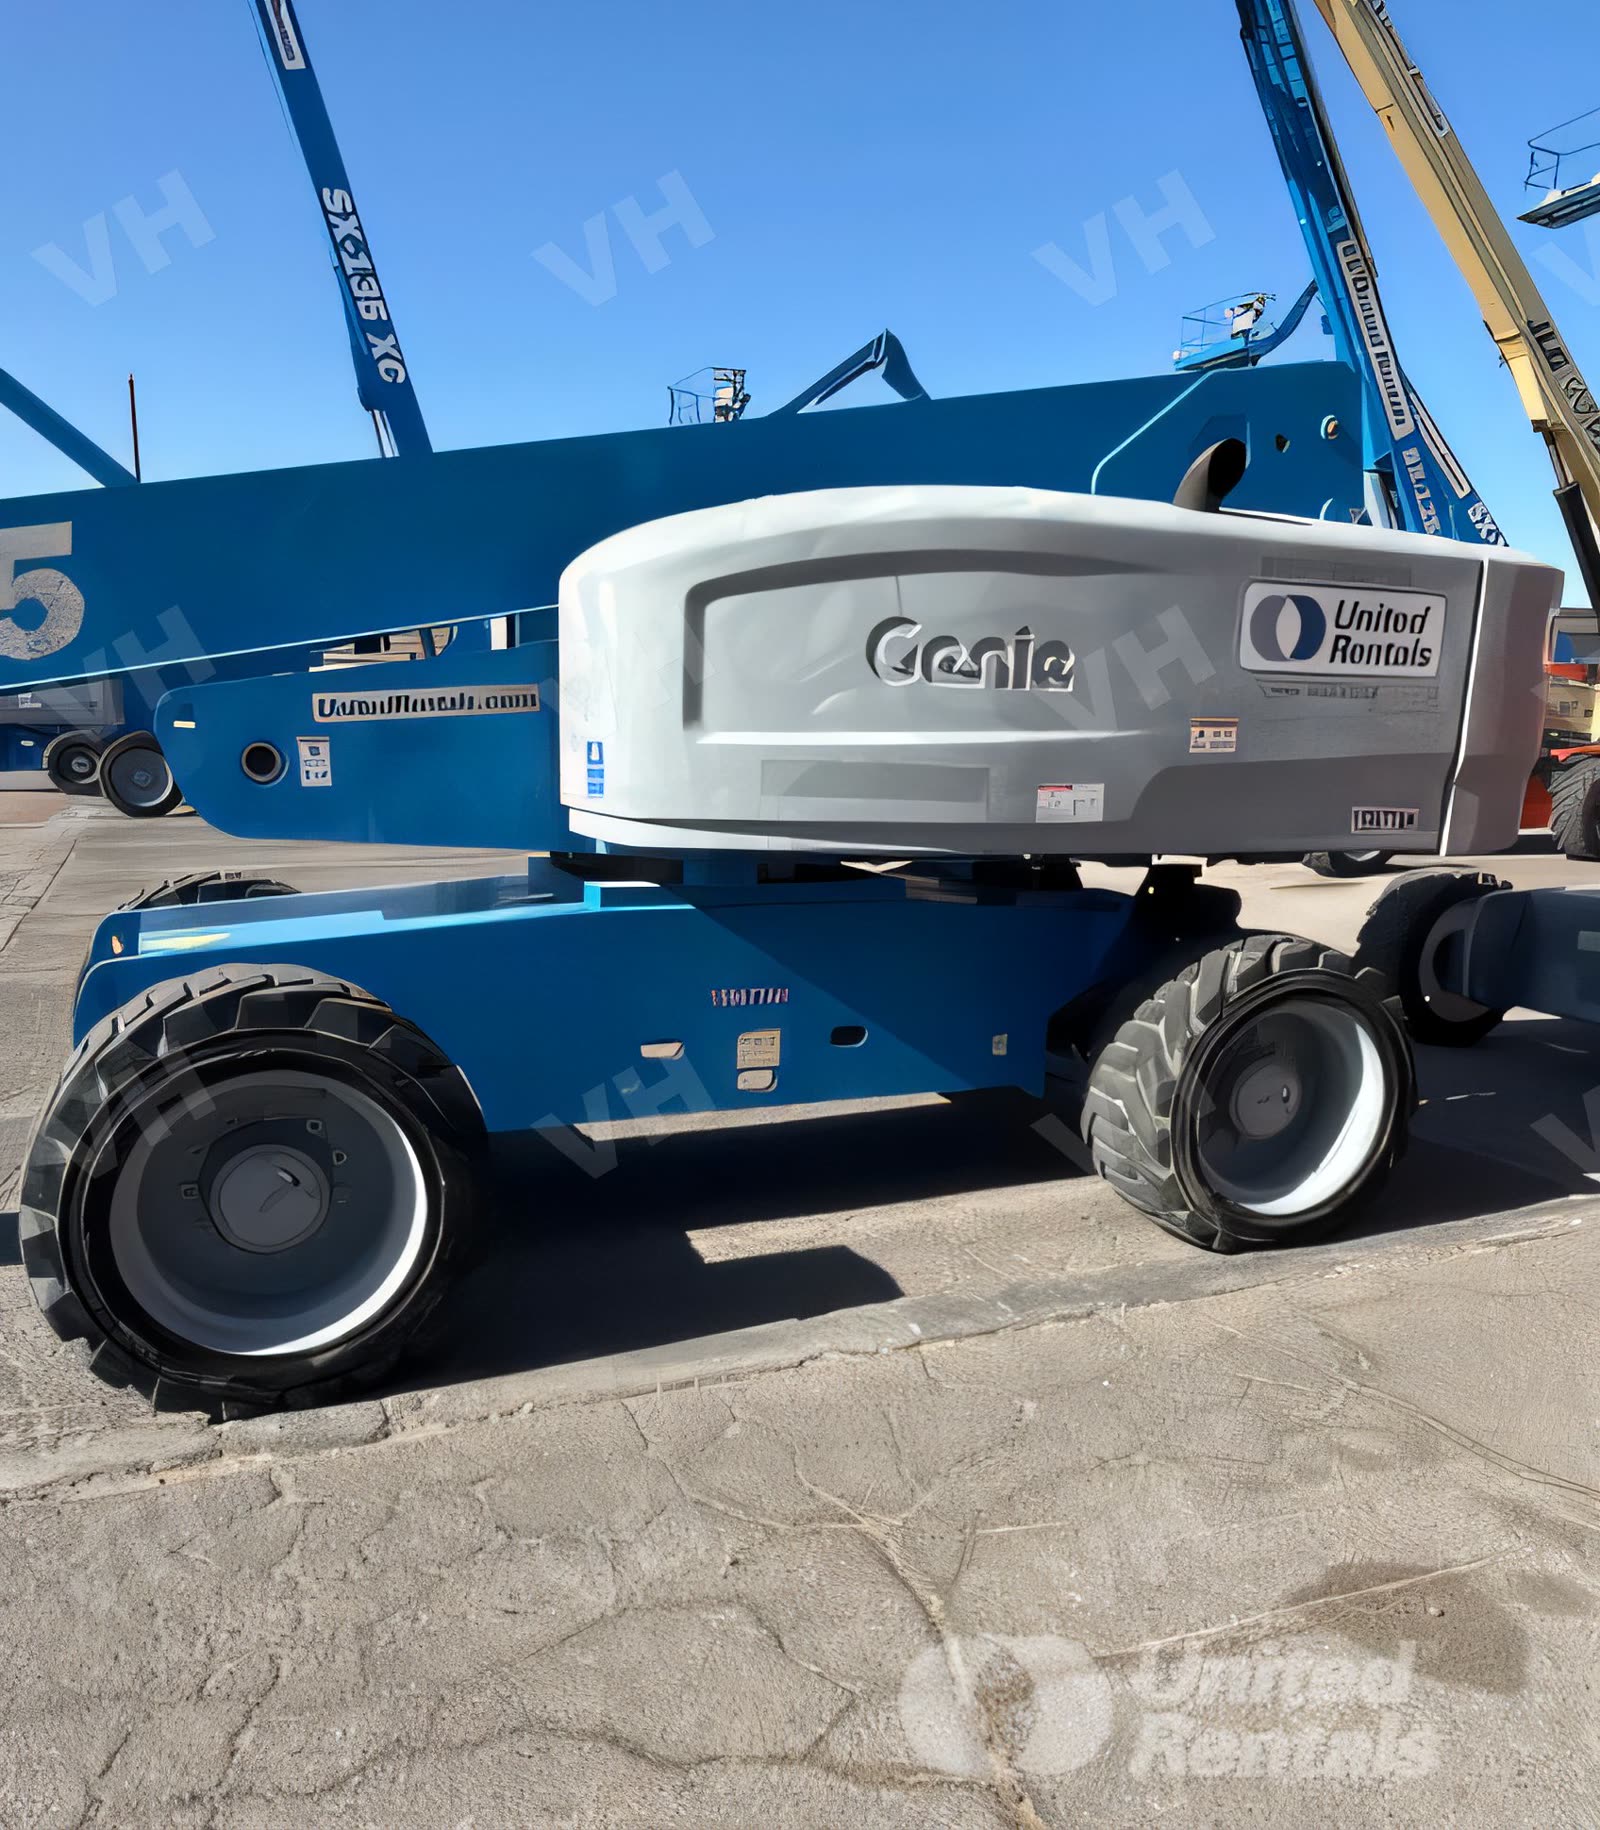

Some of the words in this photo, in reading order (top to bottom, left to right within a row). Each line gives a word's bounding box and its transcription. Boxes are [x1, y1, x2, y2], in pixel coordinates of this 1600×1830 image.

[322, 187, 389, 321] SX-135
[365, 332, 406, 384] XC
[865, 615, 1076, 692] Genie
